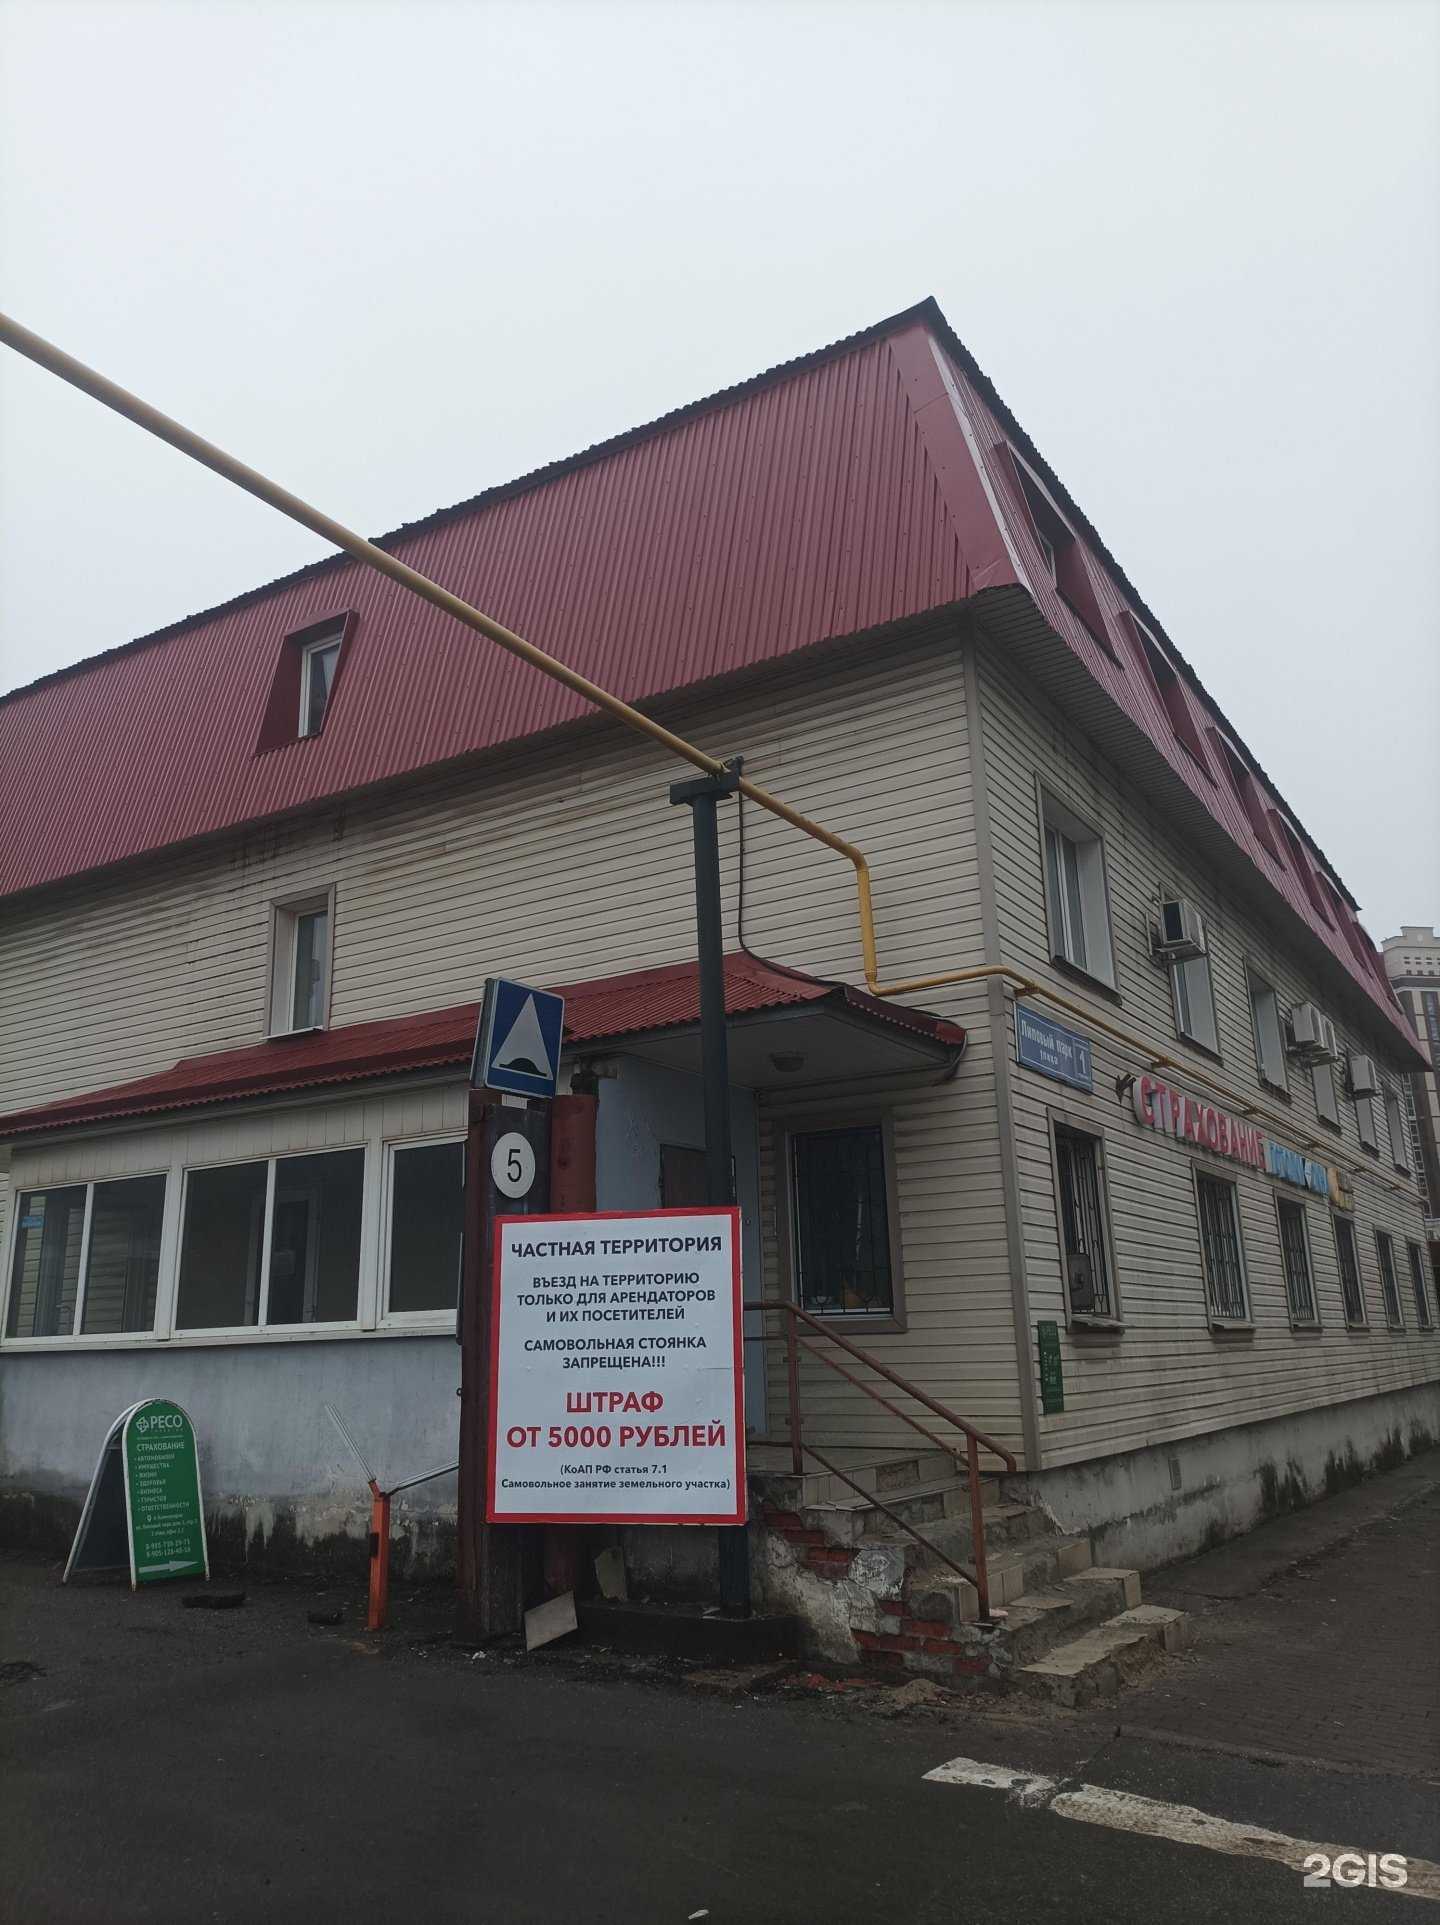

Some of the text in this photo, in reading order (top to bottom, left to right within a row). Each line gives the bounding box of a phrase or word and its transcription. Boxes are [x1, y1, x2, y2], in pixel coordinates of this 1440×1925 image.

[1021, 1019, 1054, 1050] Липовый
[1055, 1039, 1073, 1061] парк
[1138, 1075, 1266, 1169] СТРАХОВАНИЕ
[507, 1148, 522, 1182] 5
[511, 1236, 722, 1258] ЧАСТНАЯ ТЕРРИТОРИЯ
[532, 1272, 700, 1289] ВЪЕЗД НА ТЕРРИТОРИЮ
[517, 1289, 716, 1306] ТОЛЬКО ДЛЯ АРЕНДАТОРОВ
[546, 1306, 685, 1323] И ИХ ПОСЕТИТЕЛЕЙ
[524, 1336, 706, 1352] САМОВОЛЬНАЯ СТОЯНКА
[562, 1355, 666, 1370] ЗАПРЕЩЕНА!!!
[566, 1390, 664, 1413] ШТРАФ
[150, 1415, 183, 1429] РЕСО
[506, 1419, 726, 1448] ОТ 5000 РУБЛЕЙ
[136, 1441, 184, 1452] СТРАХОВАНИЕ
[560, 1464, 667, 1475] (КоАП РФ статья 7.1
[501, 1478, 731, 1491] Самовольное занятие земельного участка)
